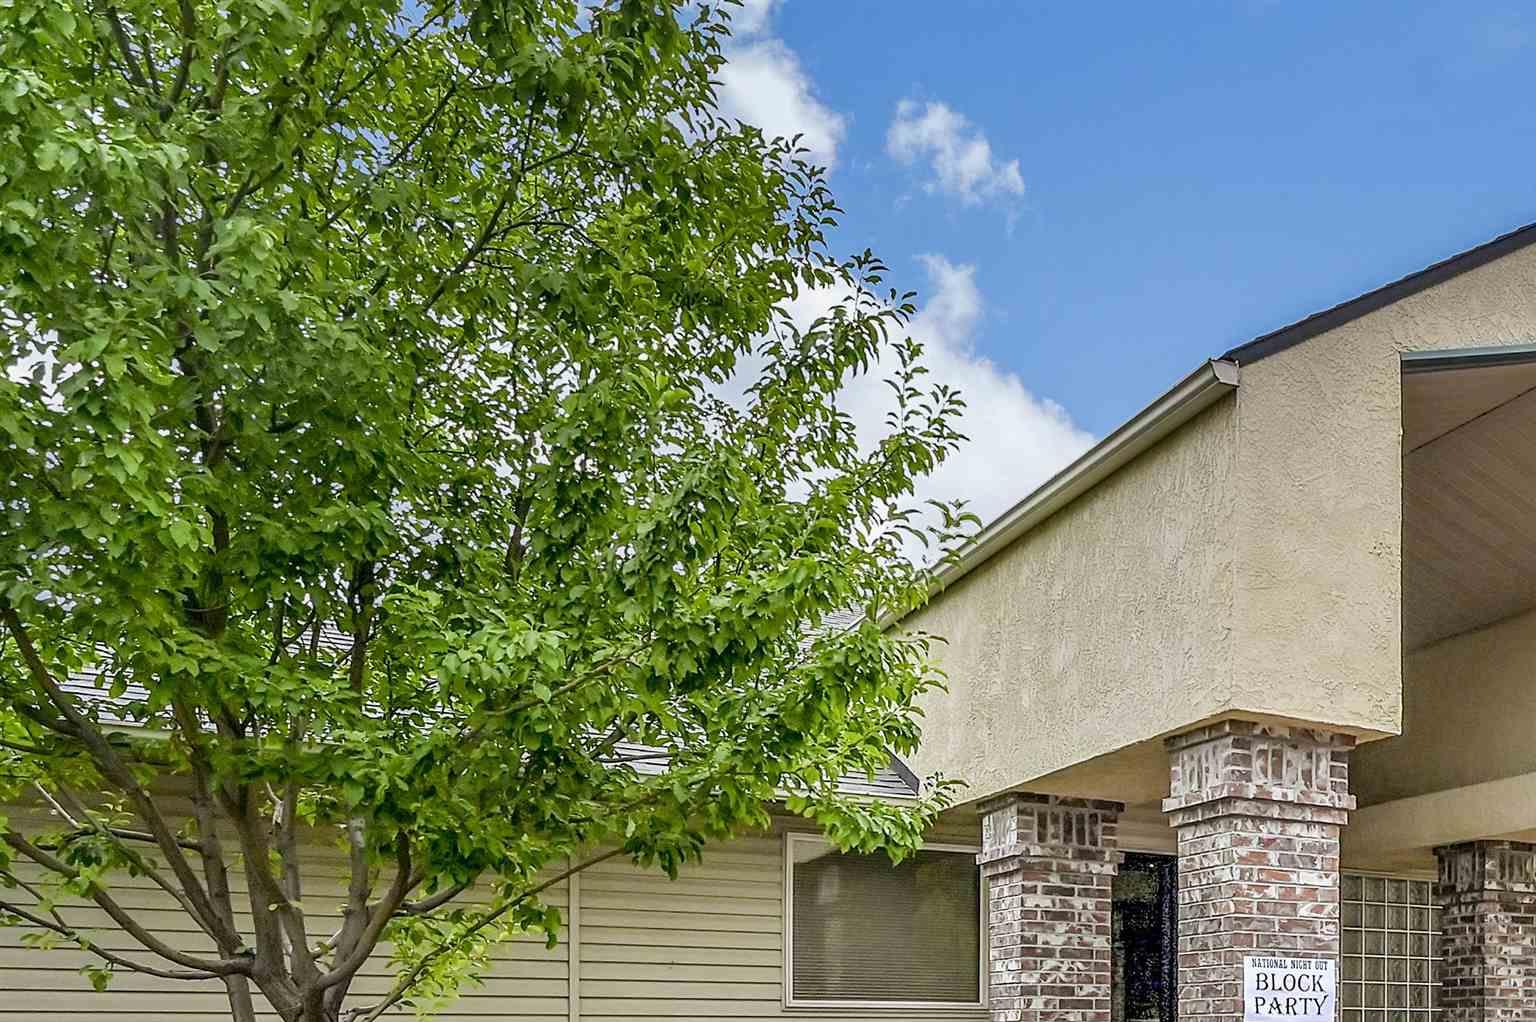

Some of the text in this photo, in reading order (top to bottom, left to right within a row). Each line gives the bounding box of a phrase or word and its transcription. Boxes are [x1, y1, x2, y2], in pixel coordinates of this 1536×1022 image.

[1252, 958, 1328, 971] NATIONAL NIGHT OUT
[1256, 972, 1327, 993] BLOCK
[1254, 994, 1329, 1015] PARTY
